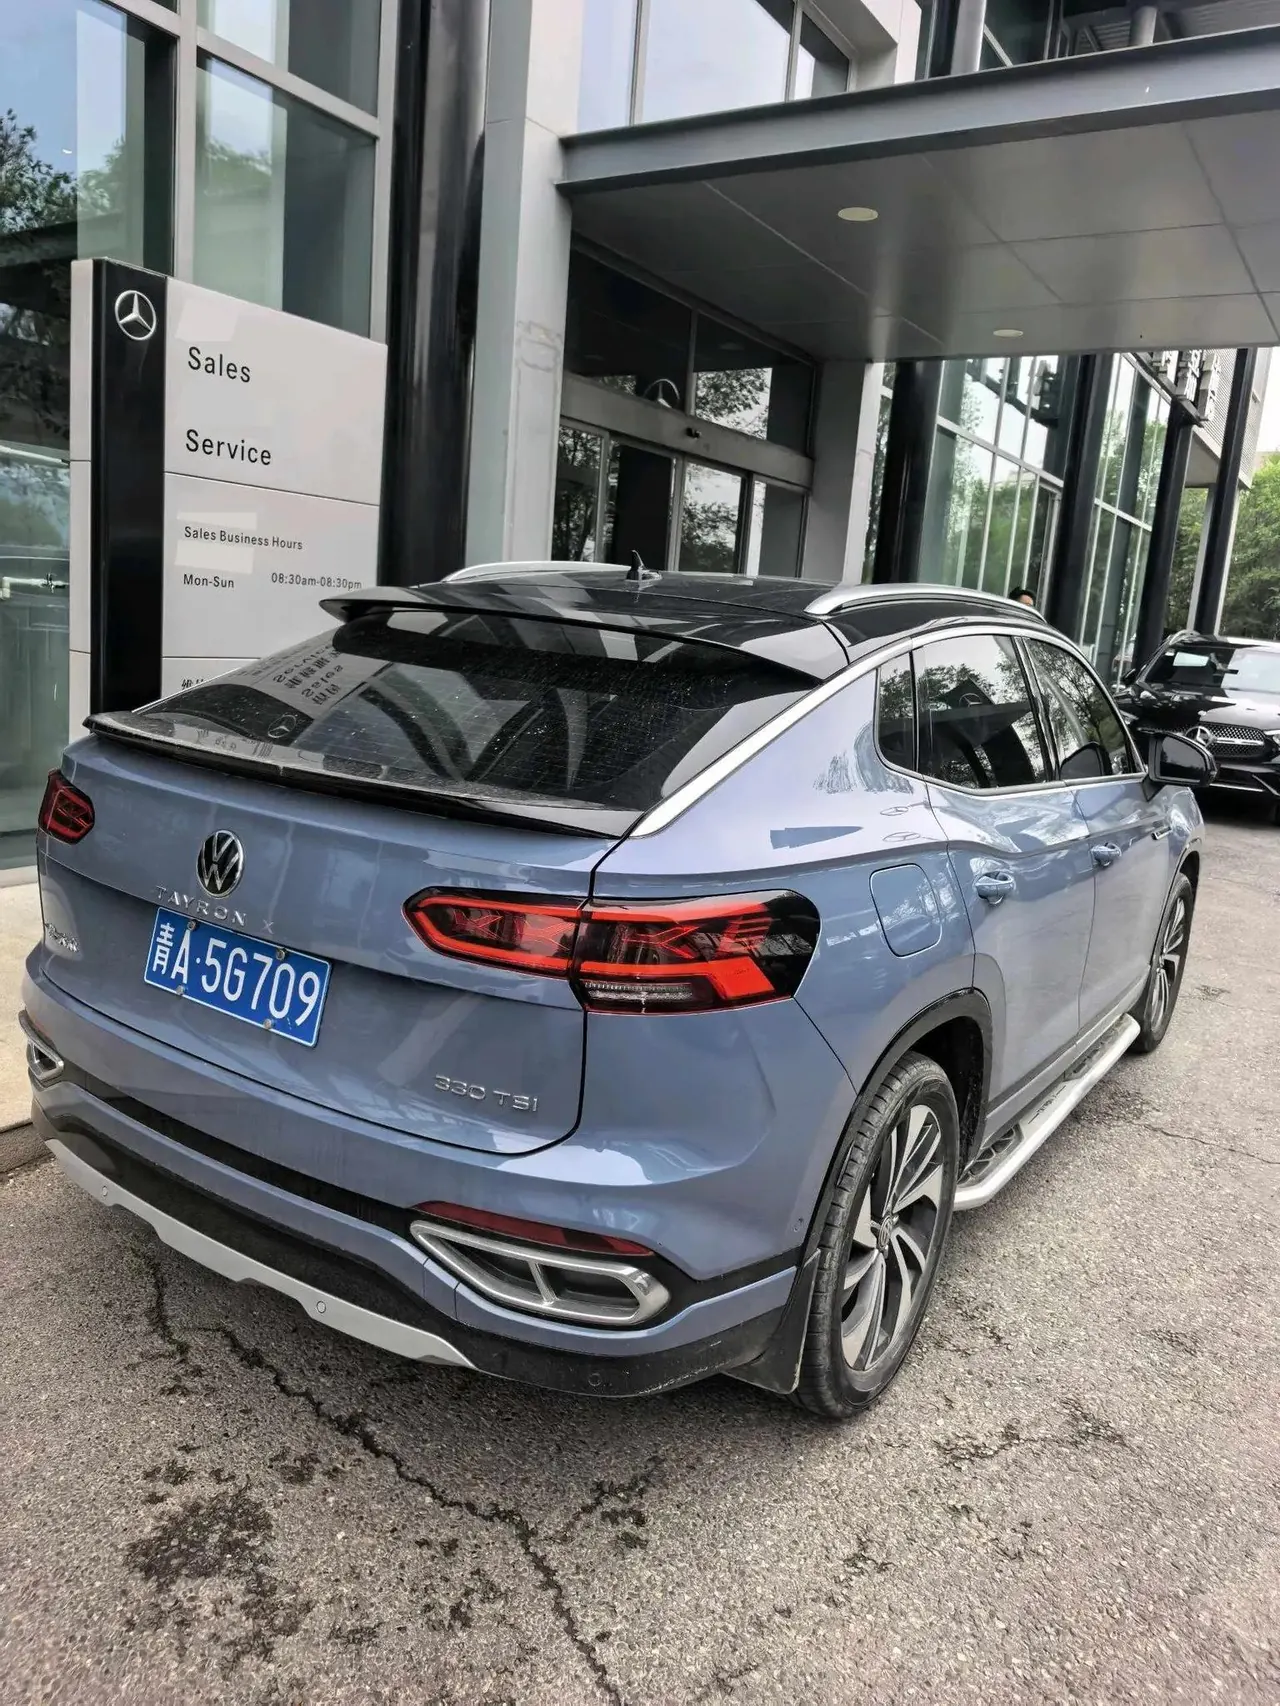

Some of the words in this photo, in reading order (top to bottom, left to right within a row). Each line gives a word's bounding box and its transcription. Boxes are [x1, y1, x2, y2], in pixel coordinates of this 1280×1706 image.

[188, 346, 251, 382] Sales
[185, 429, 271, 465] Service
[184, 526, 216, 541] Sales
[219, 530, 269, 547] Business
[272, 536, 303, 550] Hours
[183, 573, 234, 588] Mon-Sun
[271, 572, 362, 590] 08:30am-08:30pm
[156, 885, 247, 927] TAYRON
[262, 918, 275, 934] X
[434, 1074, 486, 1100] 330
[493, 1090, 538, 1112] TSI
